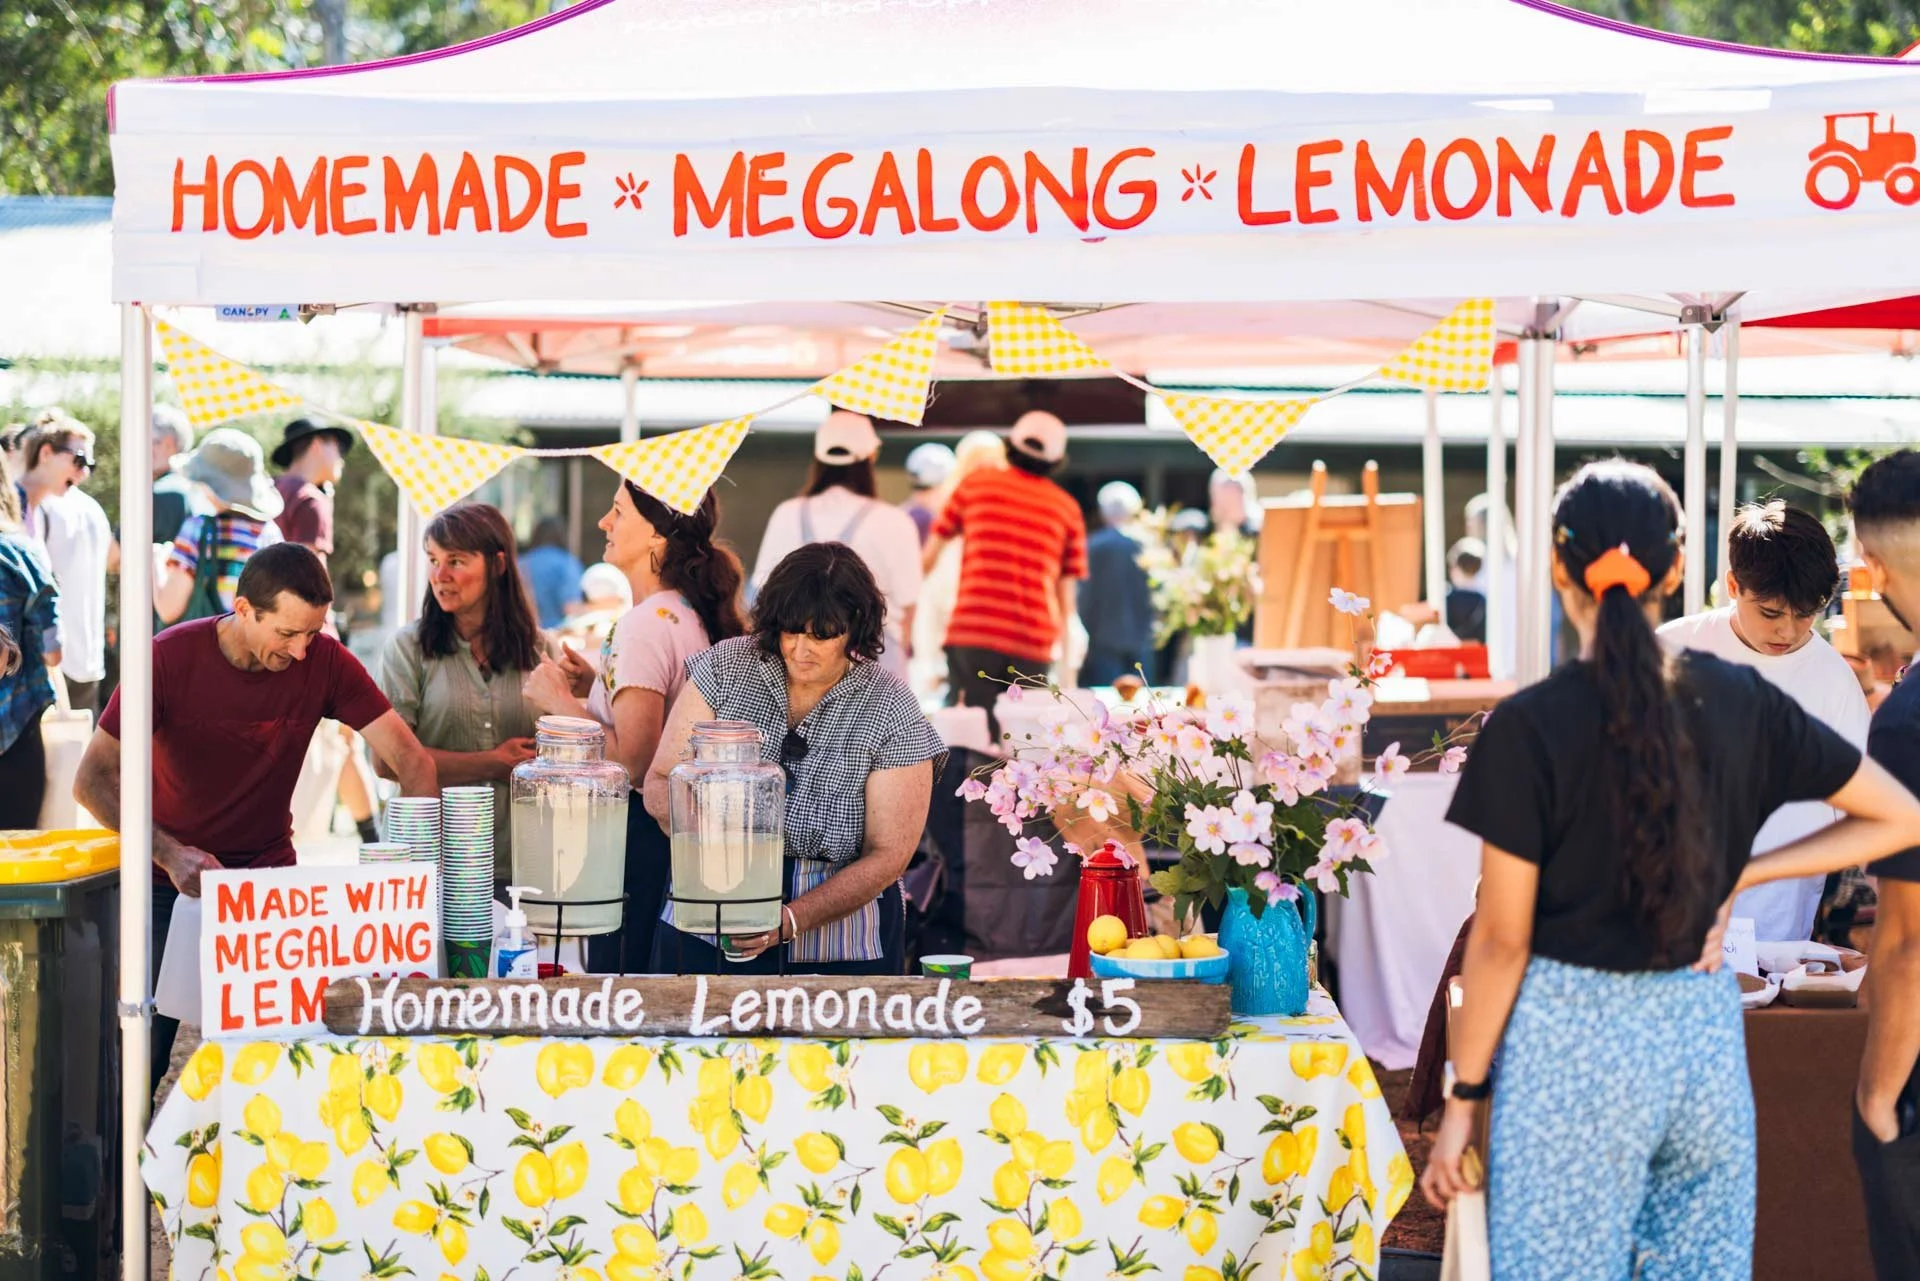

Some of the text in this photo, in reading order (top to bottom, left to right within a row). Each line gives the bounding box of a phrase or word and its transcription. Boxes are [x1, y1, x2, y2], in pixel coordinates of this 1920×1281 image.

[172, 125, 1735, 239] HOMEMADE MEGALONG LEMONADE
[218, 875, 428, 923] MADE WITH
[216, 921, 432, 973] MEGALONG
[355, 976, 1142, 1037] Homemade Lemonade $5
